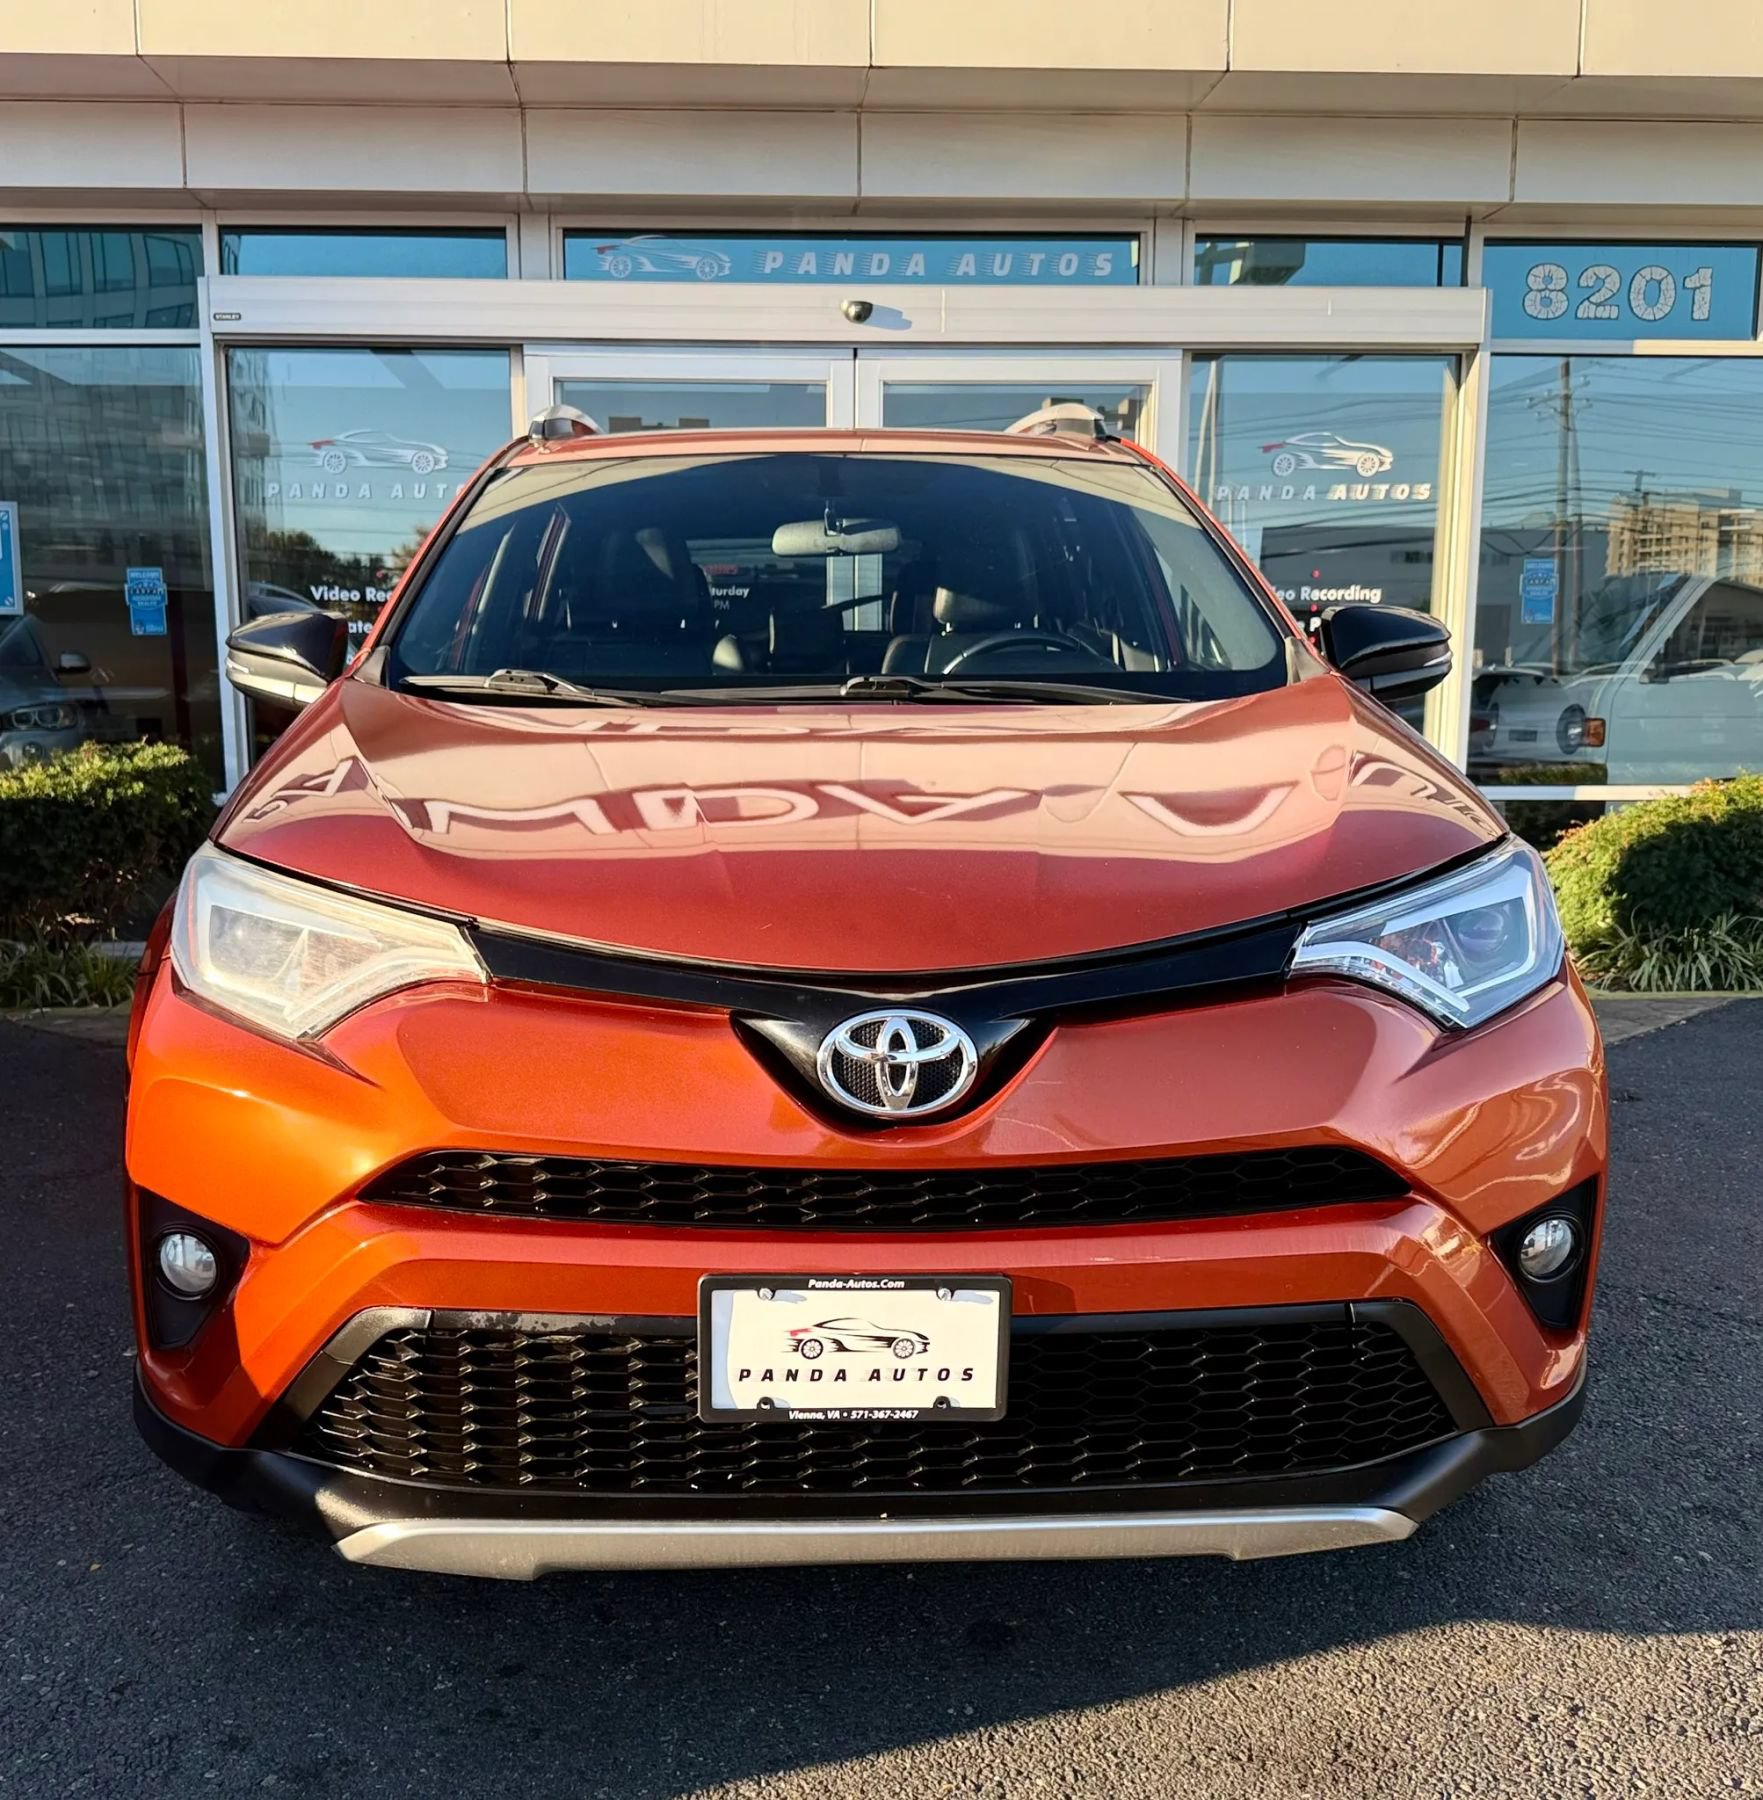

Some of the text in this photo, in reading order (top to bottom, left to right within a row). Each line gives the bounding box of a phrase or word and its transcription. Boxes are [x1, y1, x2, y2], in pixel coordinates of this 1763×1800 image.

[763, 251, 1113, 277] PANDA AUTOS
[1522, 262, 1713, 322] 8201
[267, 483, 372, 499] PANDA
[1216, 483, 1432, 501] PANDA AUTOS
[310, 585, 361, 602] Video
[1300, 584, 1383, 603] Recording
[808, 1279, 905, 1289] Panda-Autos.Com
[738, 1367, 974, 1382] PANDA AUTOS
[788, 1410, 919, 1420] Vienna, VA 571-367-2467
